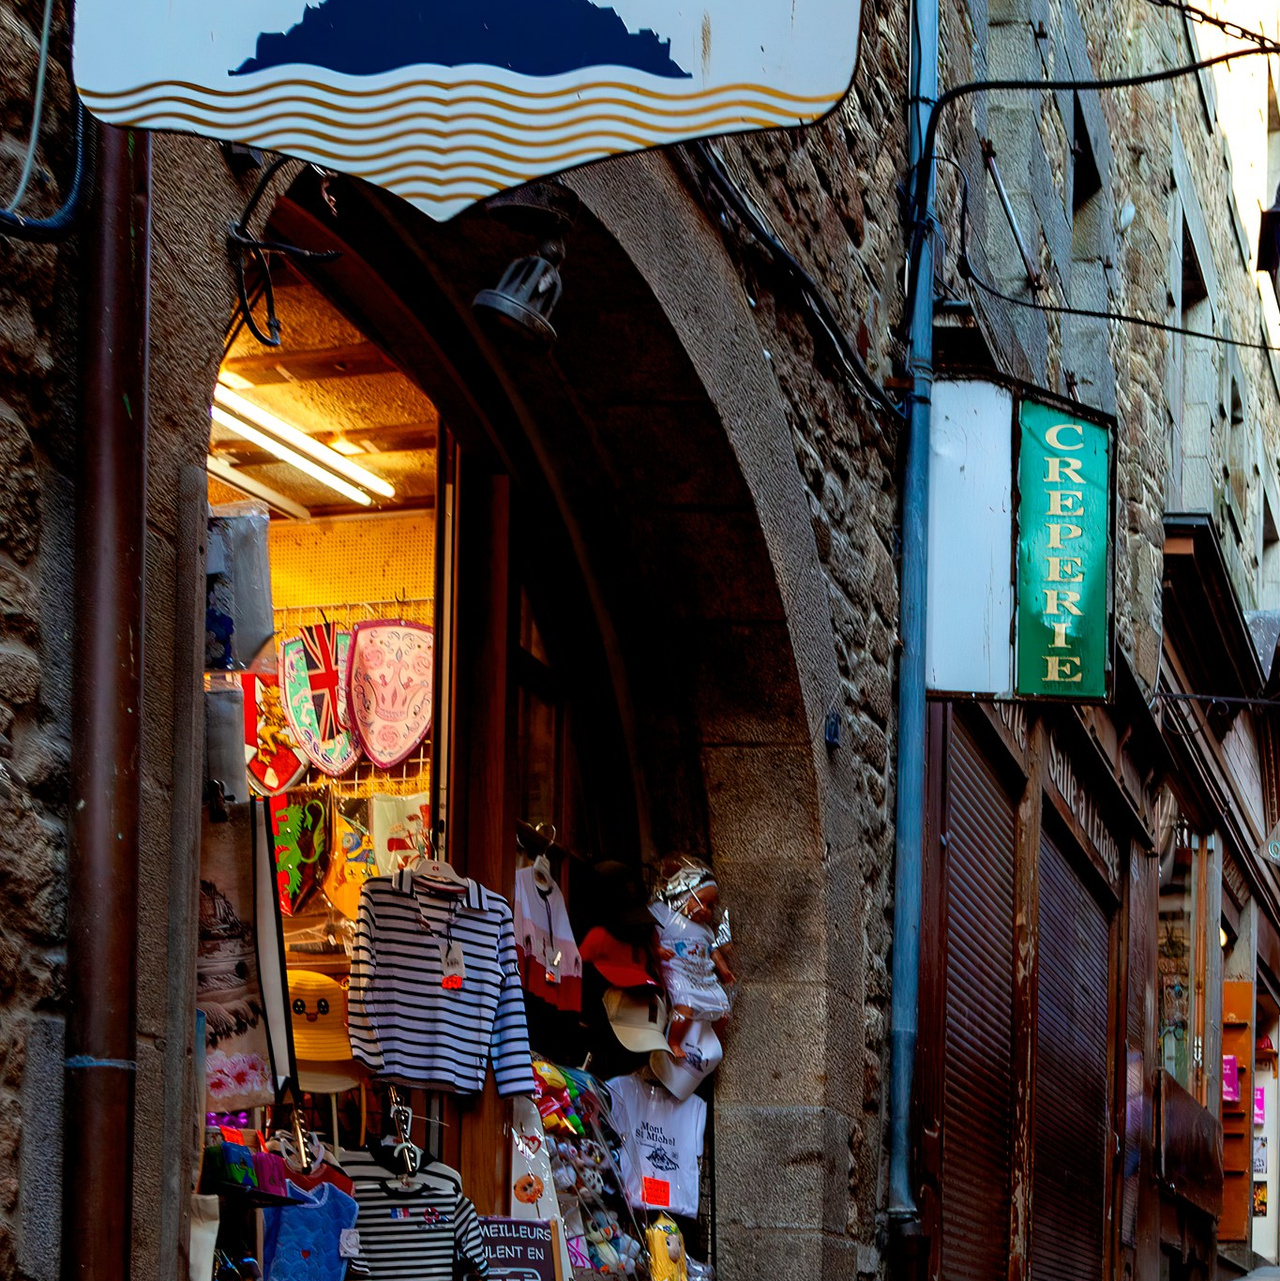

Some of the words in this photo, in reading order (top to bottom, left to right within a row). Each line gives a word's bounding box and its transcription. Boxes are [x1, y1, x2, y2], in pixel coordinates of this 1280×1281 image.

[1042, 424, 1087, 683] CREPERIE
[641, 1121, 663, 1135] Mont
[646, 1131, 676, 1146] Michel
[480, 1224, 552, 1241] MEILLEURS
[527, 1246, 545, 1260] EN
